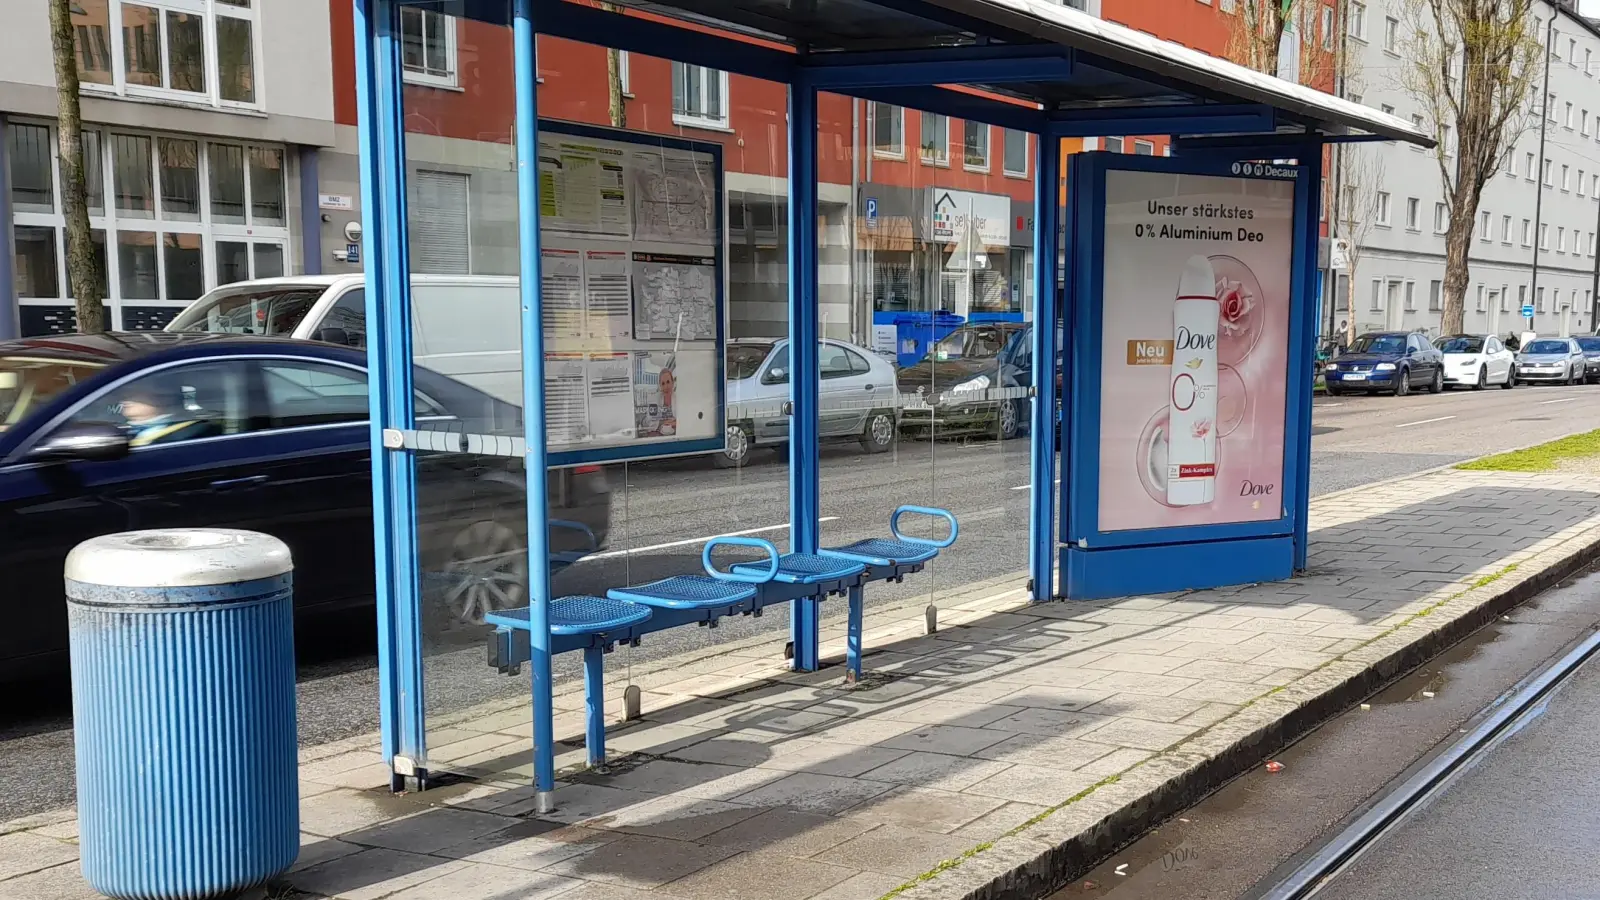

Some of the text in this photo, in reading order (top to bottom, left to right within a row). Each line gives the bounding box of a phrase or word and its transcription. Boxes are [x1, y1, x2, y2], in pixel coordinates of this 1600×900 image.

[1265, 165, 1298, 177] Decaux
[1147, 200, 1254, 220] Unser stärkstes
[1160, 224, 1233, 241] Aluminium
[1237, 227, 1264, 242] Deo
[347, 246, 359, 254] 141
[1176, 326, 1215, 350] Dove
[1136, 341, 1165, 357] Neu
[1240, 480, 1274, 497] Dove
